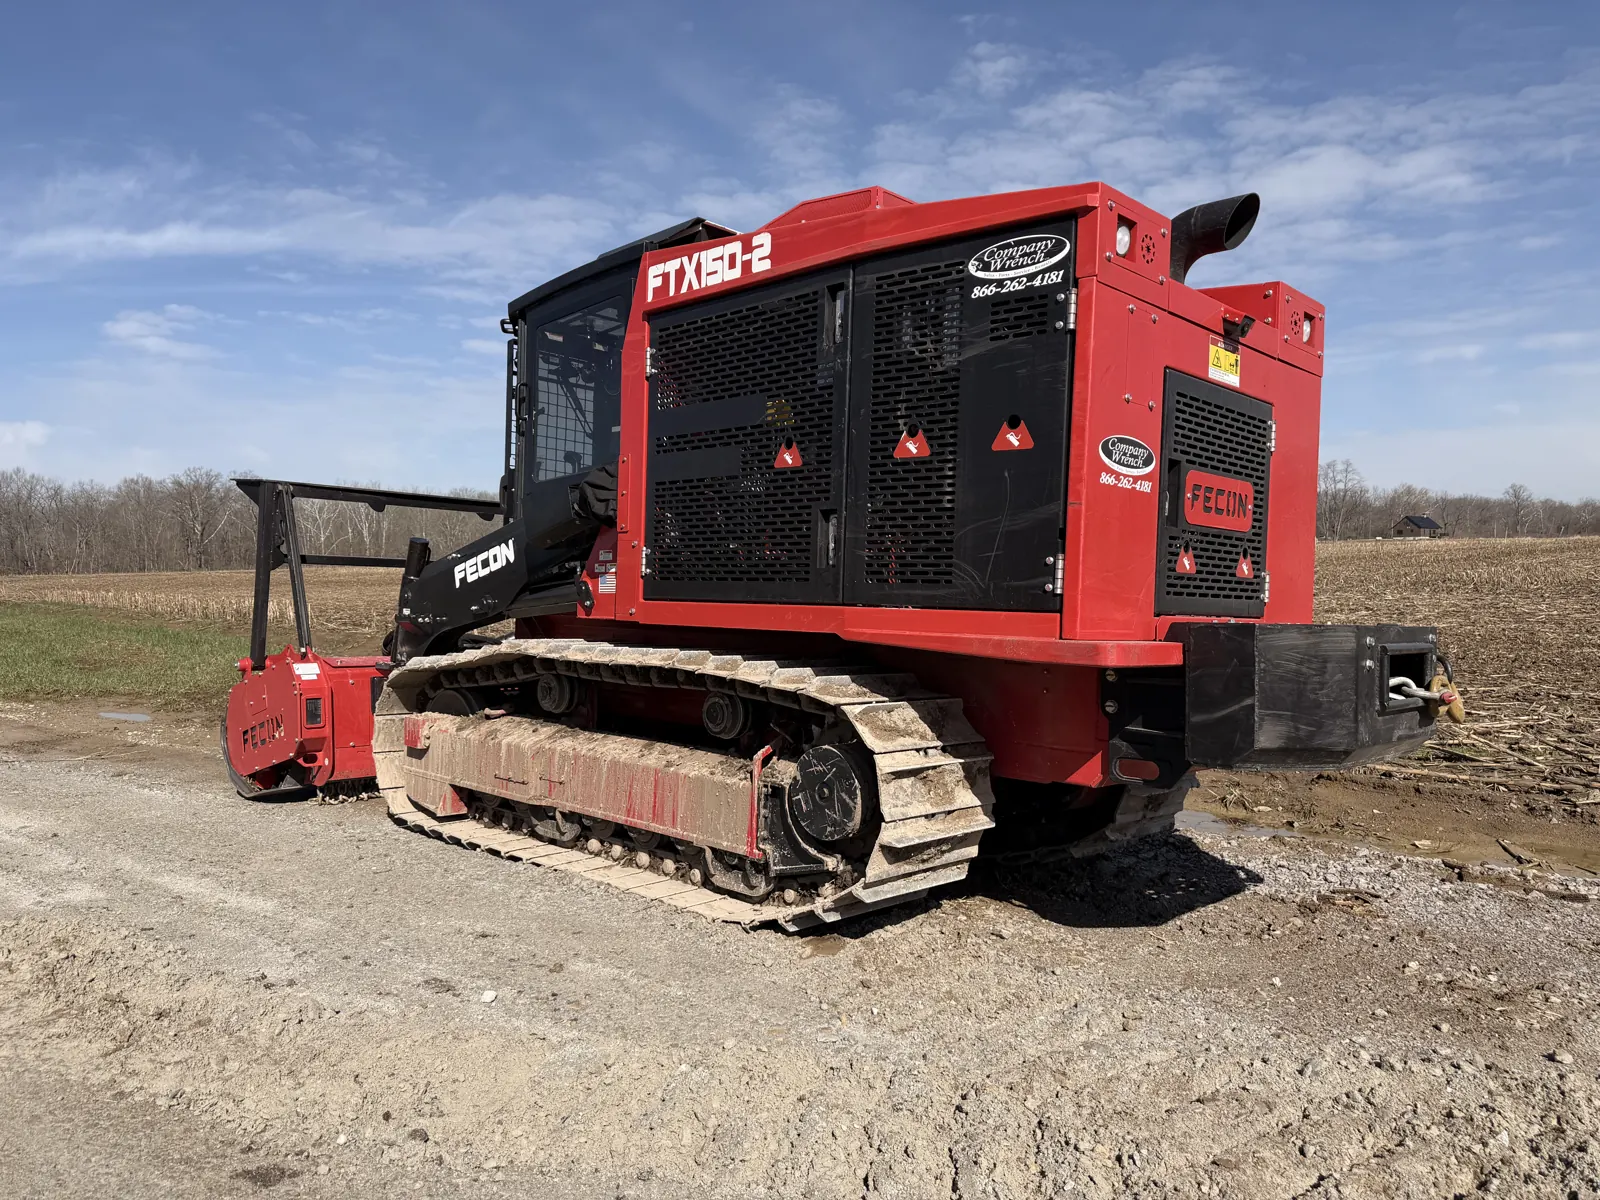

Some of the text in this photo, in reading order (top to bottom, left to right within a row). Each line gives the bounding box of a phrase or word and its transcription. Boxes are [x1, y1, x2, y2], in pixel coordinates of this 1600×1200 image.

[984, 239, 1056, 261] Company
[990, 250, 1045, 271] Wrench
[647, 232, 772, 302] FTX150-2
[971, 270, 1065, 298] 866-262-4181
[1108, 438, 1149, 460] Company
[1112, 450, 1142, 468] Wrench
[1100, 472, 1152, 493] 866-262-4181
[1190, 483, 1248, 520] FECON
[454, 538, 515, 589] FECON
